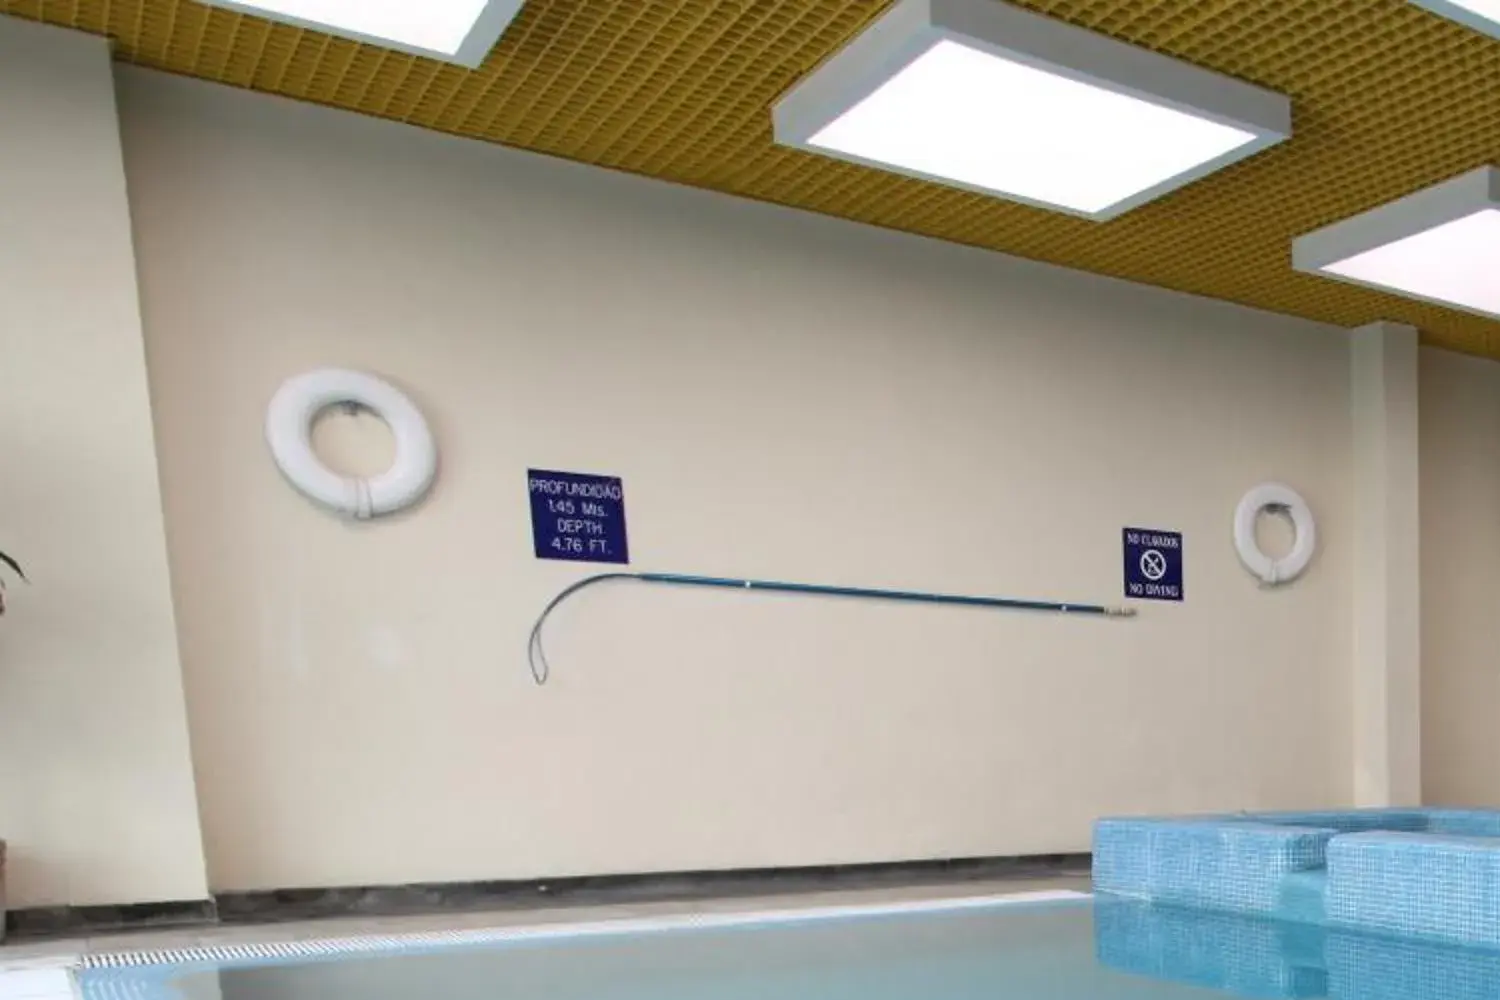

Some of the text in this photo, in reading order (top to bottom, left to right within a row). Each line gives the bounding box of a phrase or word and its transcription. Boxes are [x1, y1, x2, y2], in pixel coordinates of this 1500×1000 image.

[530, 479, 621, 500] PROFUNDIDAD
[551, 537, 583, 553] 4.76
[1127, 532, 1140, 545] NO
[1129, 583, 1179, 597] NO DIVING
